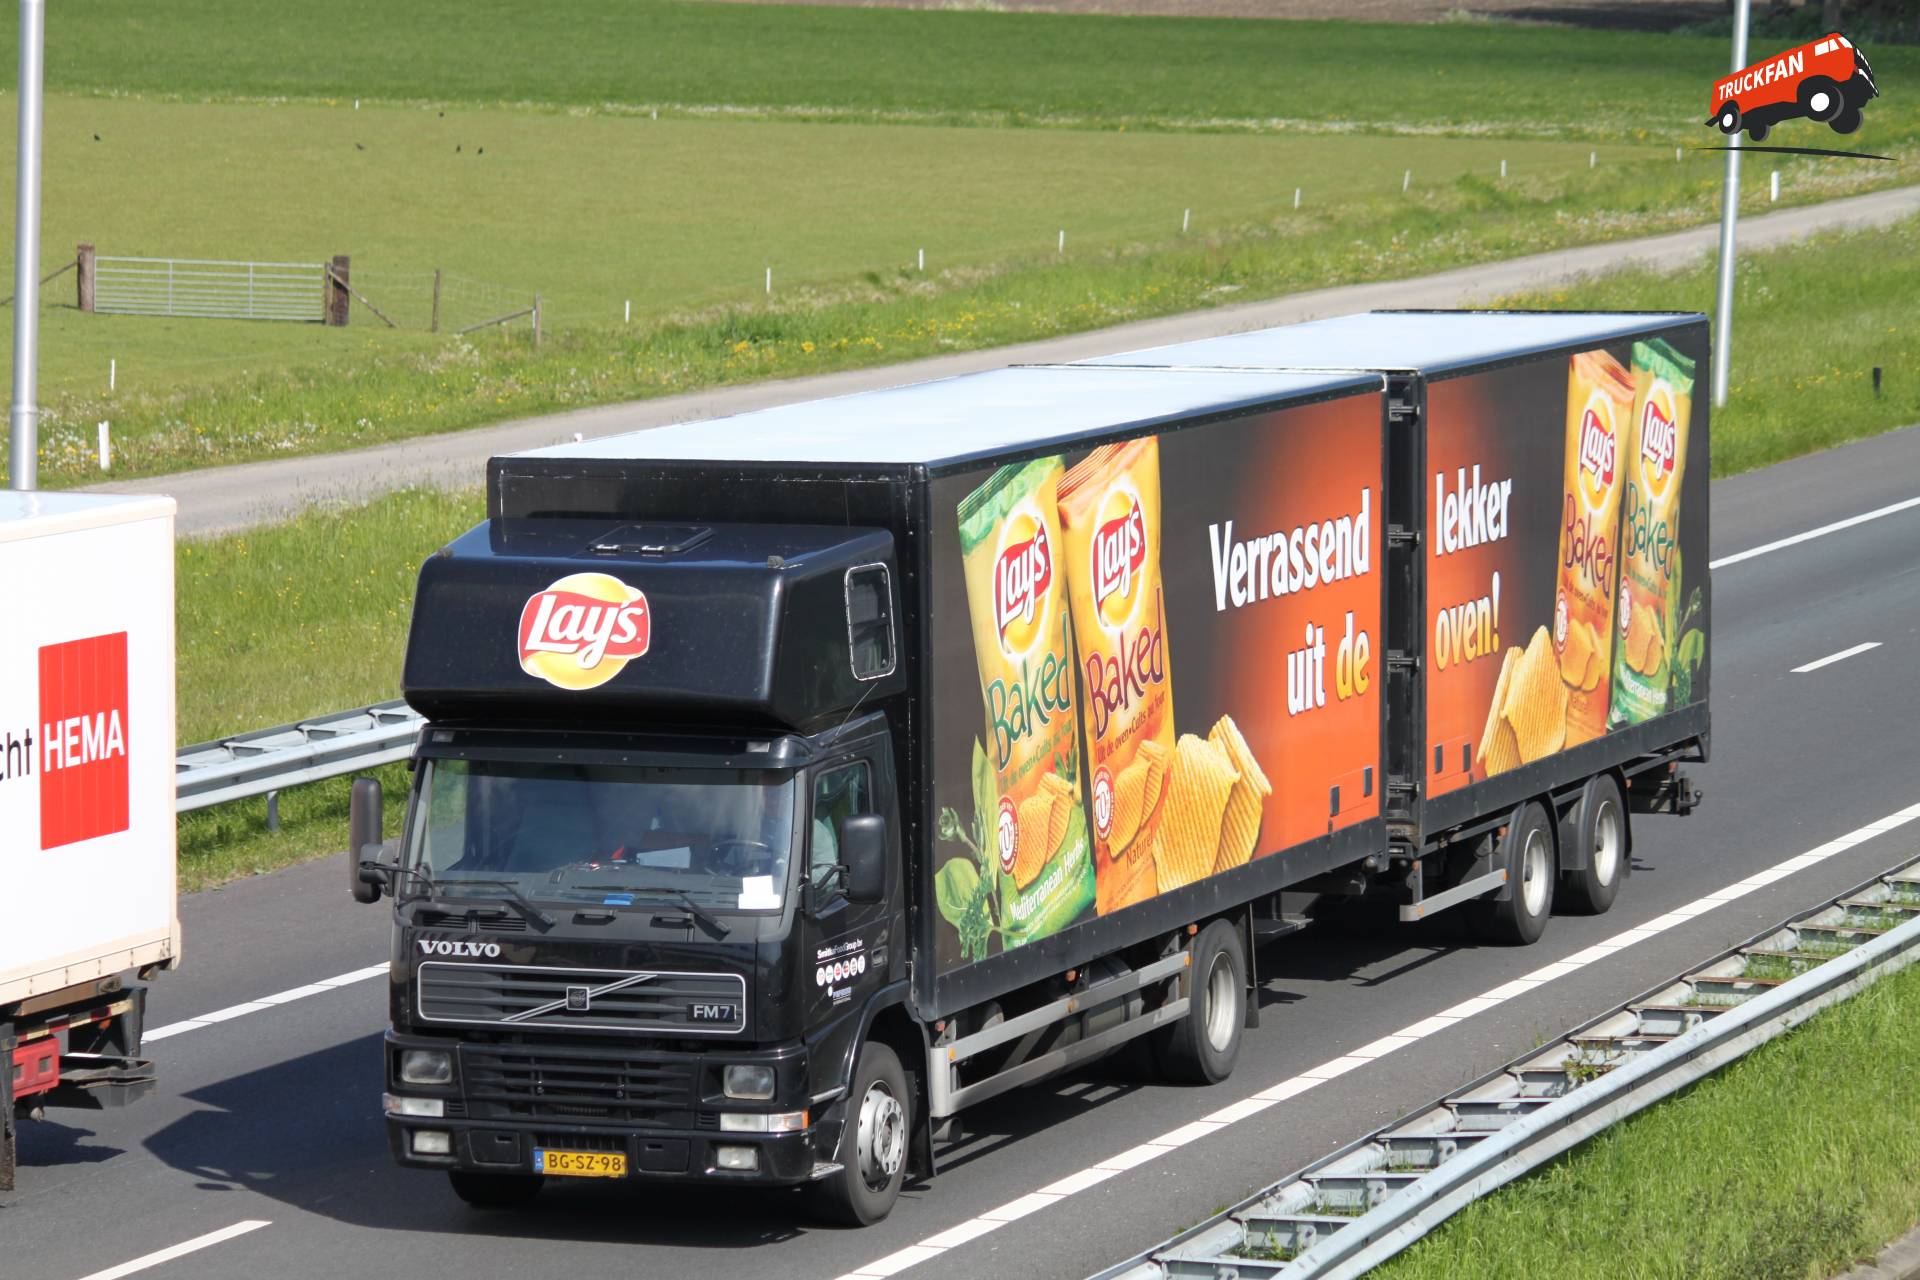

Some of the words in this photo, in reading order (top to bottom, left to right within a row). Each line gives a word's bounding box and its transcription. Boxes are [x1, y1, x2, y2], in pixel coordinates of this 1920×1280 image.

[1581, 410, 1614, 492] Lay's
[1642, 402, 1675, 481] Lay's
[1208, 487, 1370, 612] Verrassend
[1435, 464, 1512, 556] lekker
[1565, 493, 1617, 600] Baked
[1628, 482, 1679, 580] Baked
[1000, 532, 1046, 630] Lay's
[1097, 511, 1141, 603] Lay's
[525, 594, 644, 670] Lay's
[1085, 587, 1165, 742] Baked
[1287, 621, 1326, 717] uit
[1336, 611, 1371, 702] de
[1435, 571, 1500, 671] oven!
[987, 612, 1071, 772] Baked
[44, 709, 125, 773] HEMA
[1010, 866, 1063, 921] Mediterranean
[1064, 838, 1085, 875] Herbs
[418, 939, 500, 958] VOLVO
[548, 1153, 622, 1172] BG-SZ-98
